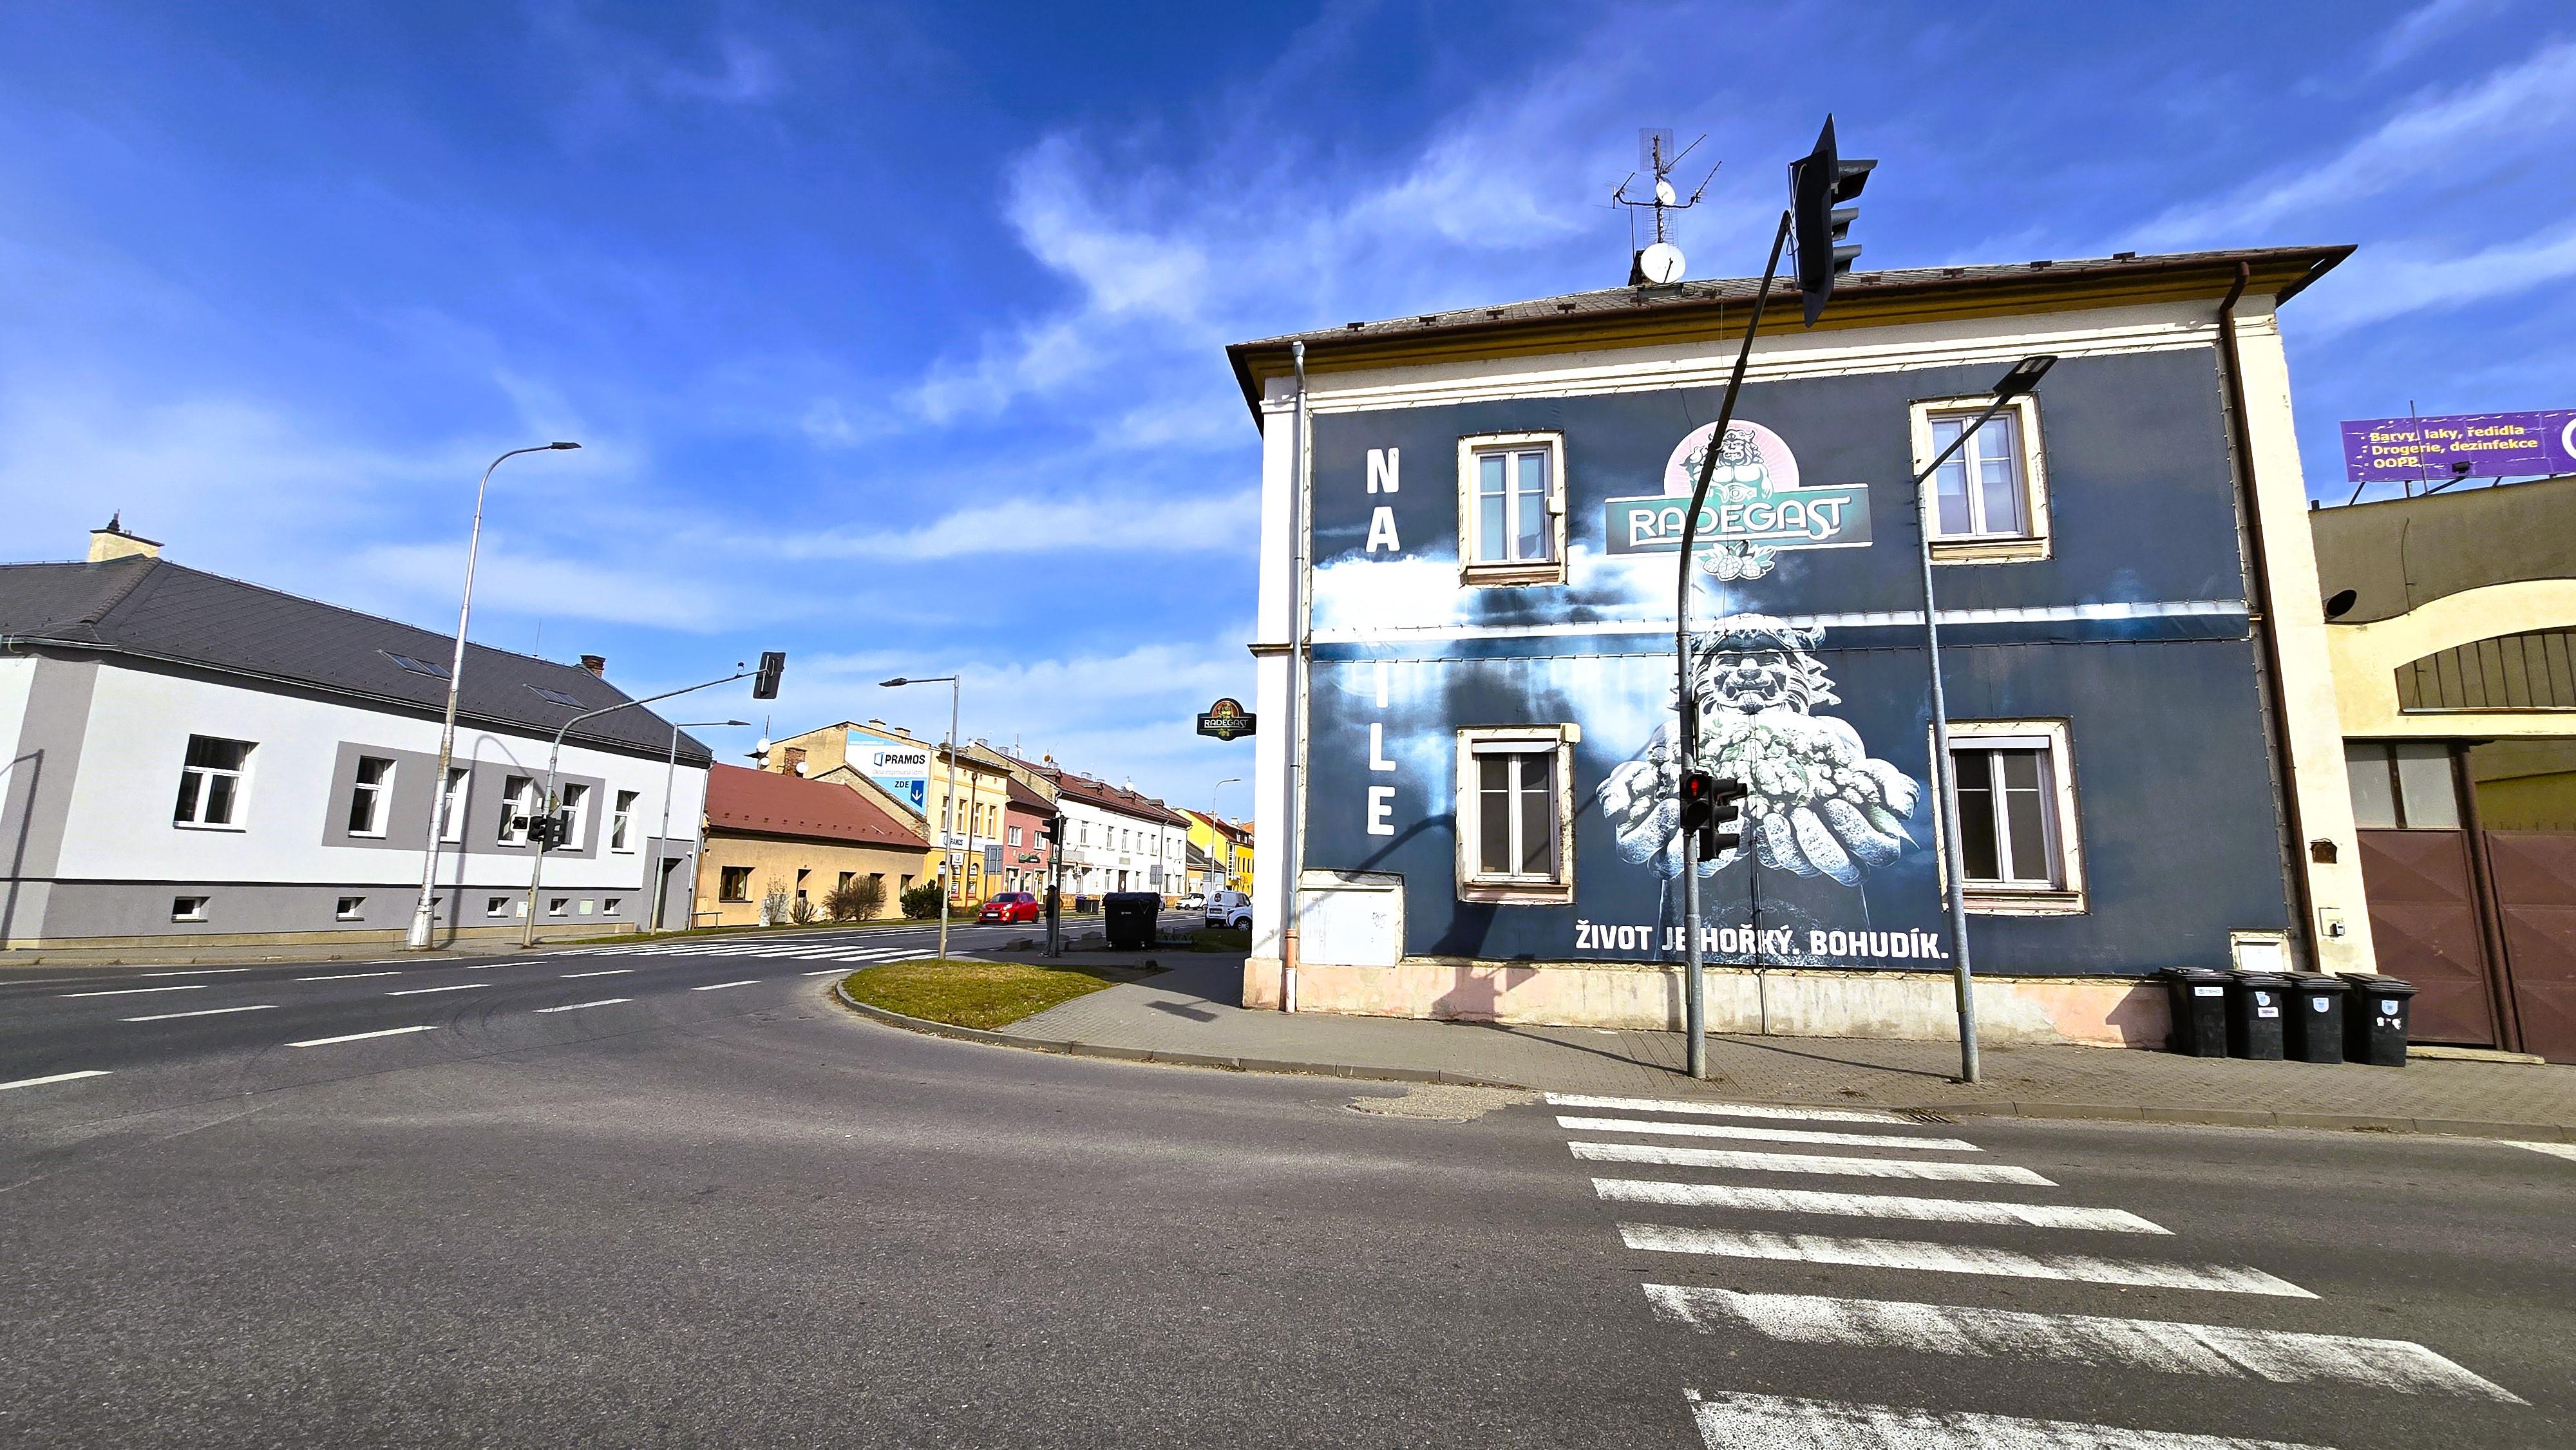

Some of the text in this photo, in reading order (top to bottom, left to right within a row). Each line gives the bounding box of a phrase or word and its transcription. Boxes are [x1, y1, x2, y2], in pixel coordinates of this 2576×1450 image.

[2425, 428, 2463, 440] laky,
[2467, 425, 2524, 437] ředidla
[2372, 439, 2538, 455] Drogerie, dezinfekce
[1366, 448, 1400, 552] NA
[1629, 495, 1851, 547] RADEGAST
[1204, 719, 1249, 728] RADEGAST
[885, 755, 925, 764] PRAMOS
[950, 838, 963, 846] RAMOS
[1575, 919, 1949, 959] ŽIVOT JE HOŘKÝ. BOHUDÍK.
